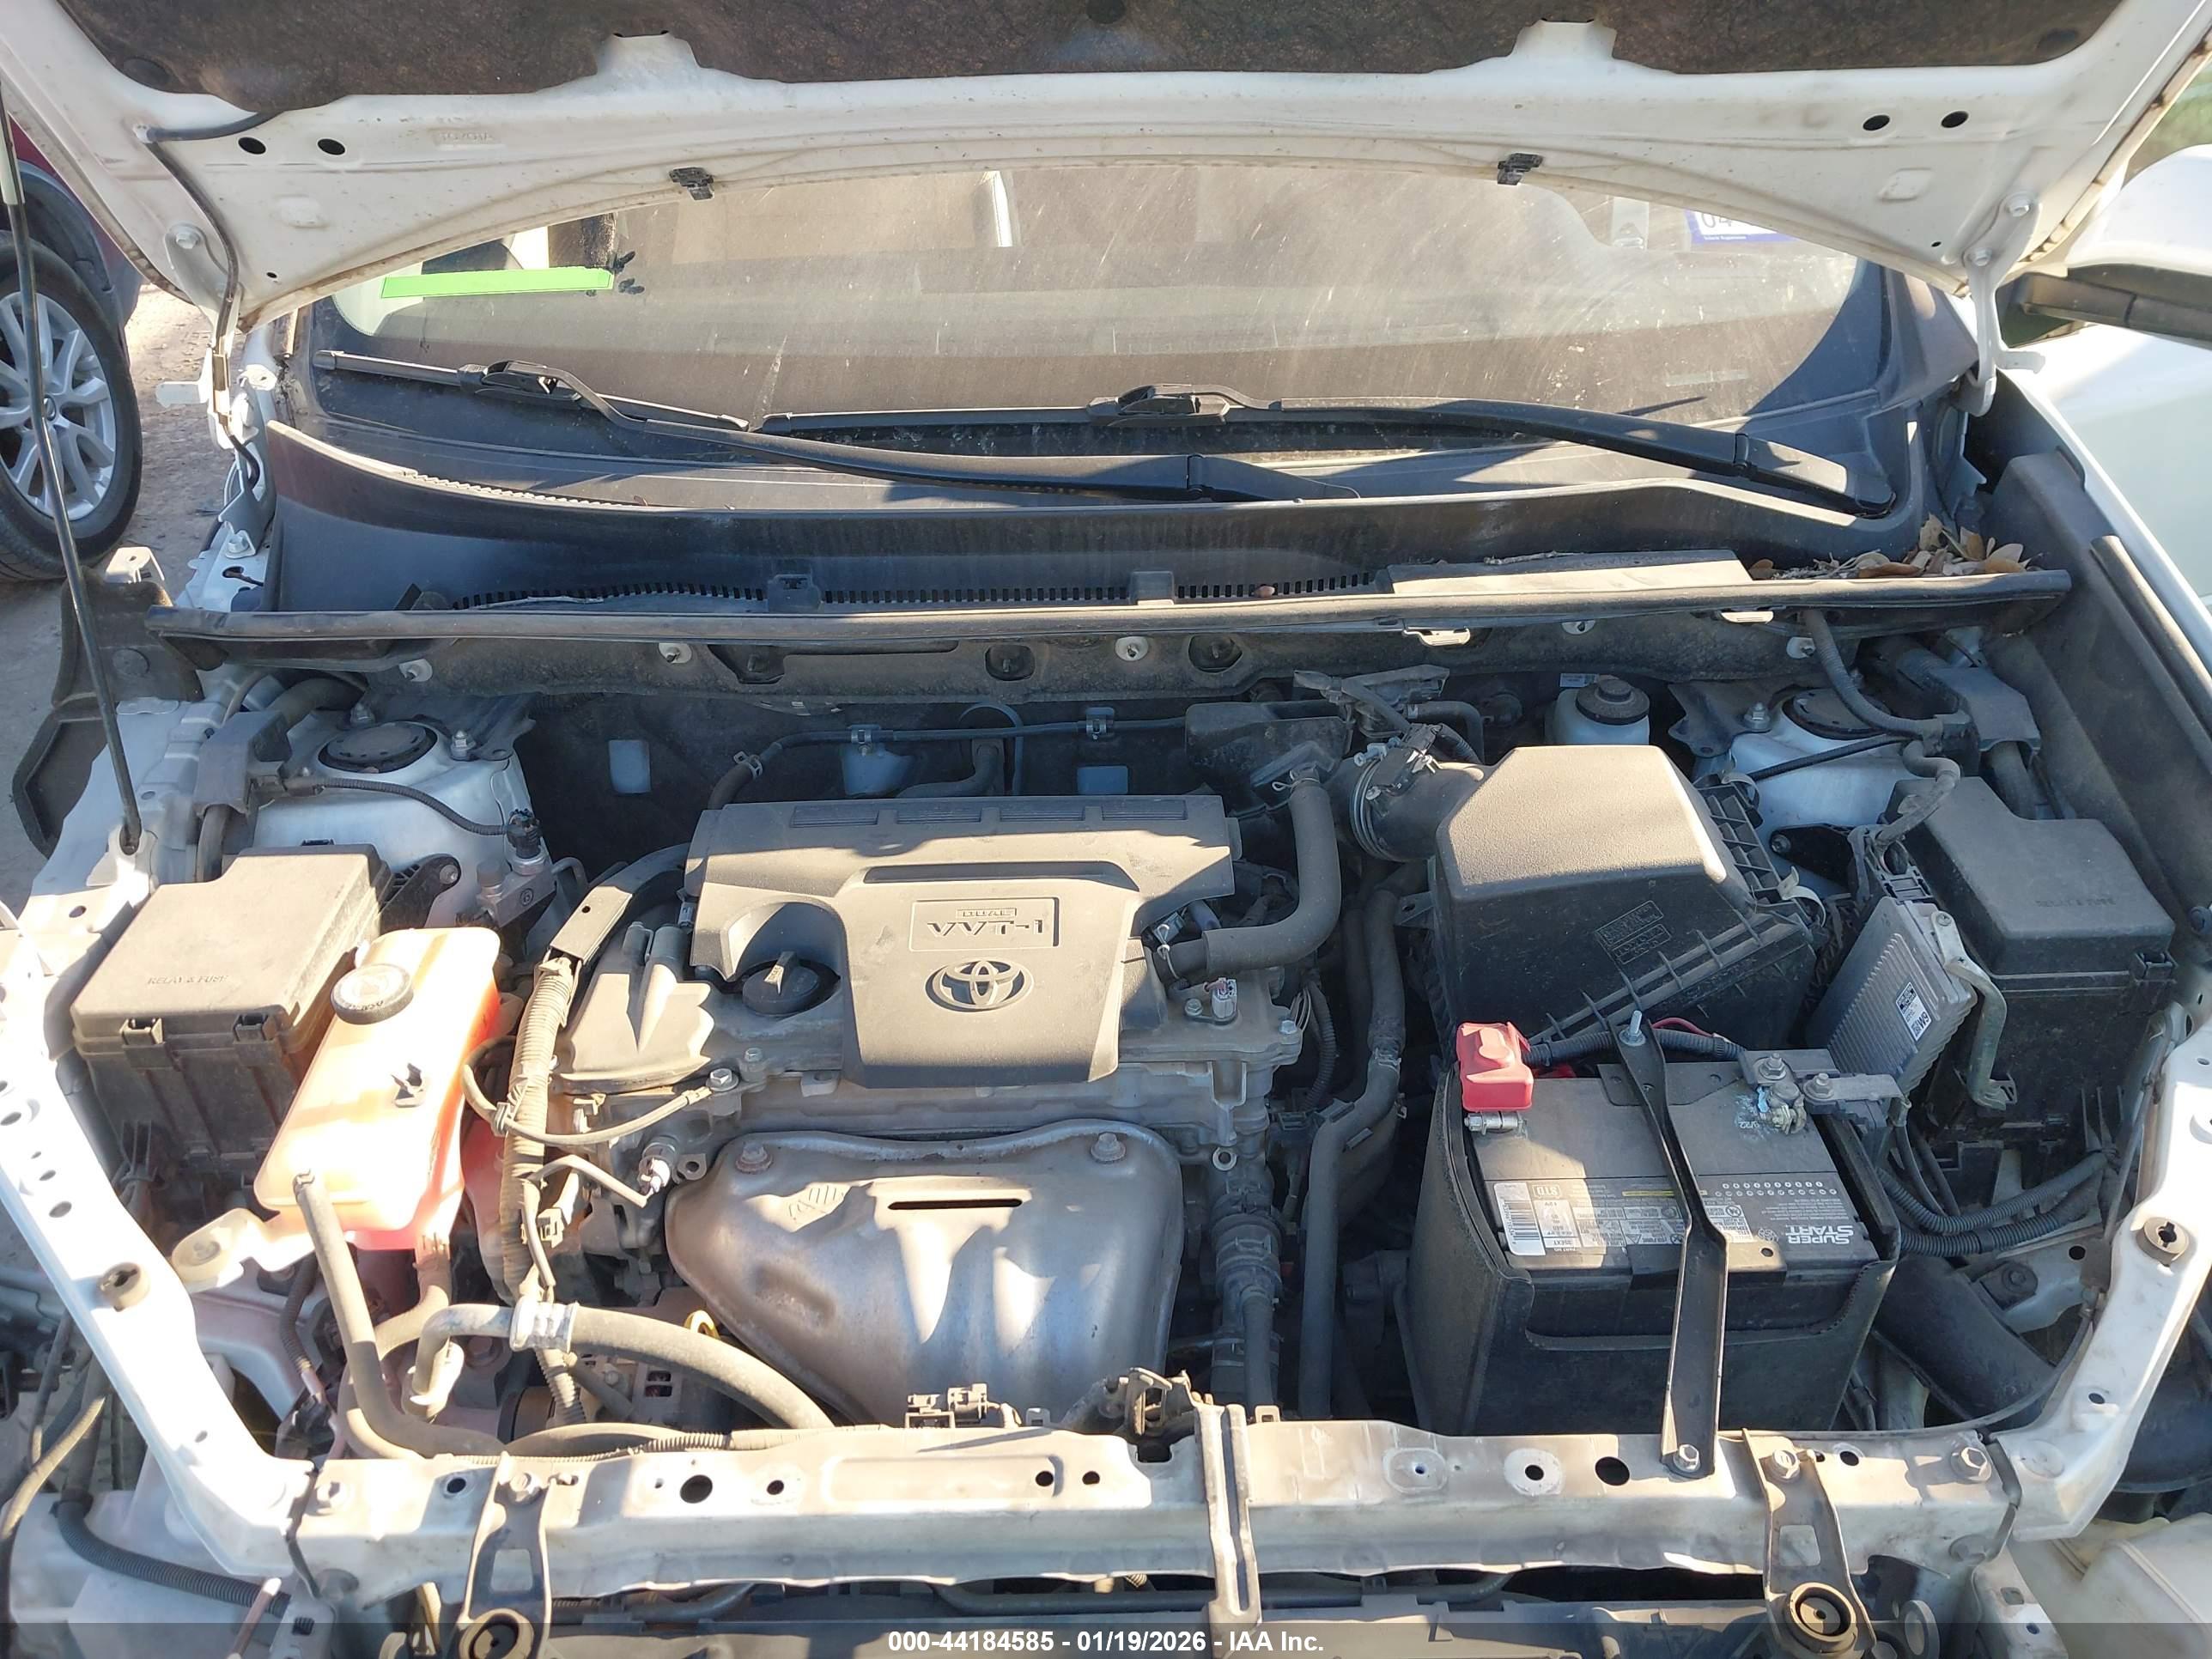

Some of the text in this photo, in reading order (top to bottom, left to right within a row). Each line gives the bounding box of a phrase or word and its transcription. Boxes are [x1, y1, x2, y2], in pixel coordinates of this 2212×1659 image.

[960, 908, 1012, 917] DUAL
[147, 975, 182, 985] RELAY
[1537, 1187, 1559, 1196] STD
[1785, 1224, 1854, 1236] START
[1788, 1235, 1850, 1244] SUPER
